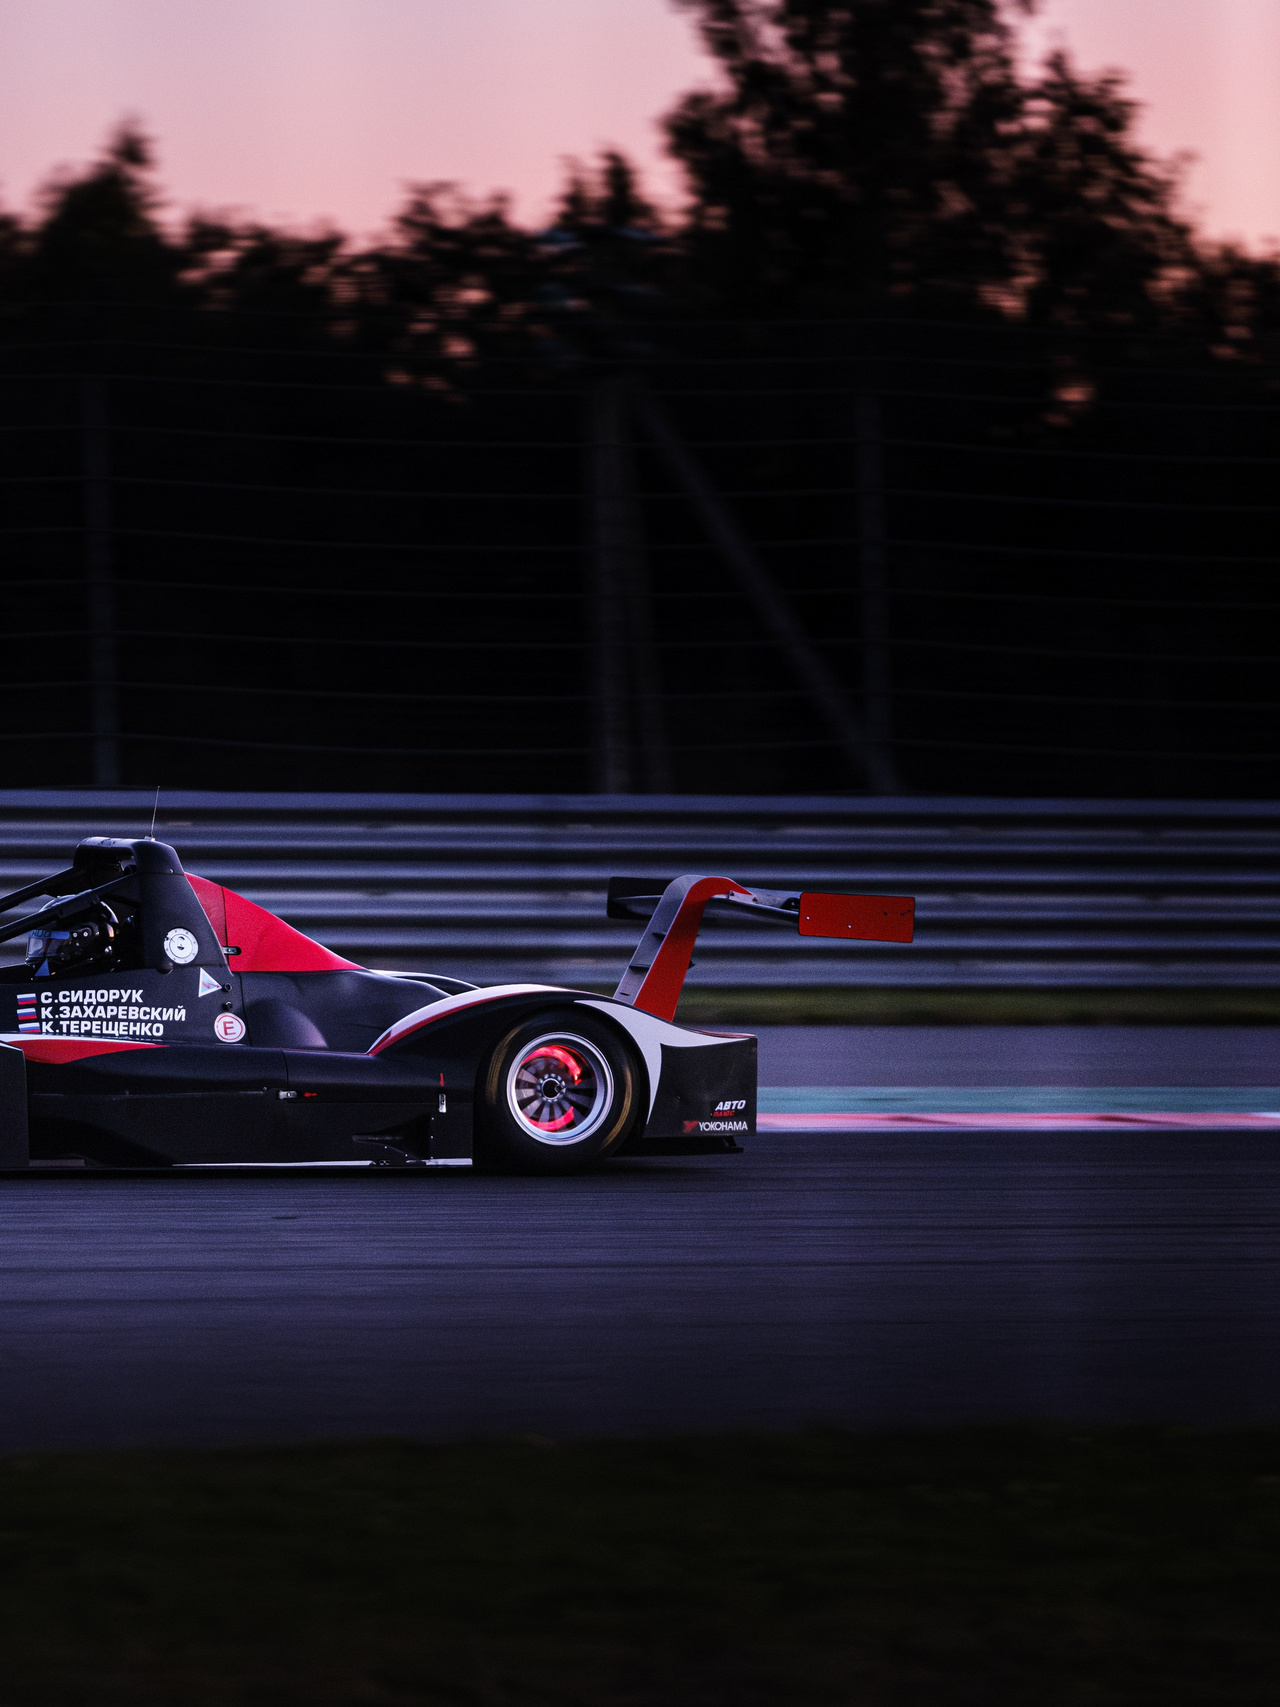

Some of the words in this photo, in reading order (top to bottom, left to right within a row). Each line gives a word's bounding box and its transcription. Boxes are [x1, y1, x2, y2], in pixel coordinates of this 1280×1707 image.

[40, 989, 144, 1005] С.СИДОРУК
[40, 1005, 187, 1021] К.ЗАХАРЕВСКИЙ
[41, 1020, 164, 1036] К.ТЕРЕЩЕНКО
[222, 1020, 237, 1036] E
[715, 1100, 746, 1111] АВТО
[698, 1120, 749, 1132] YOKOHAMA
